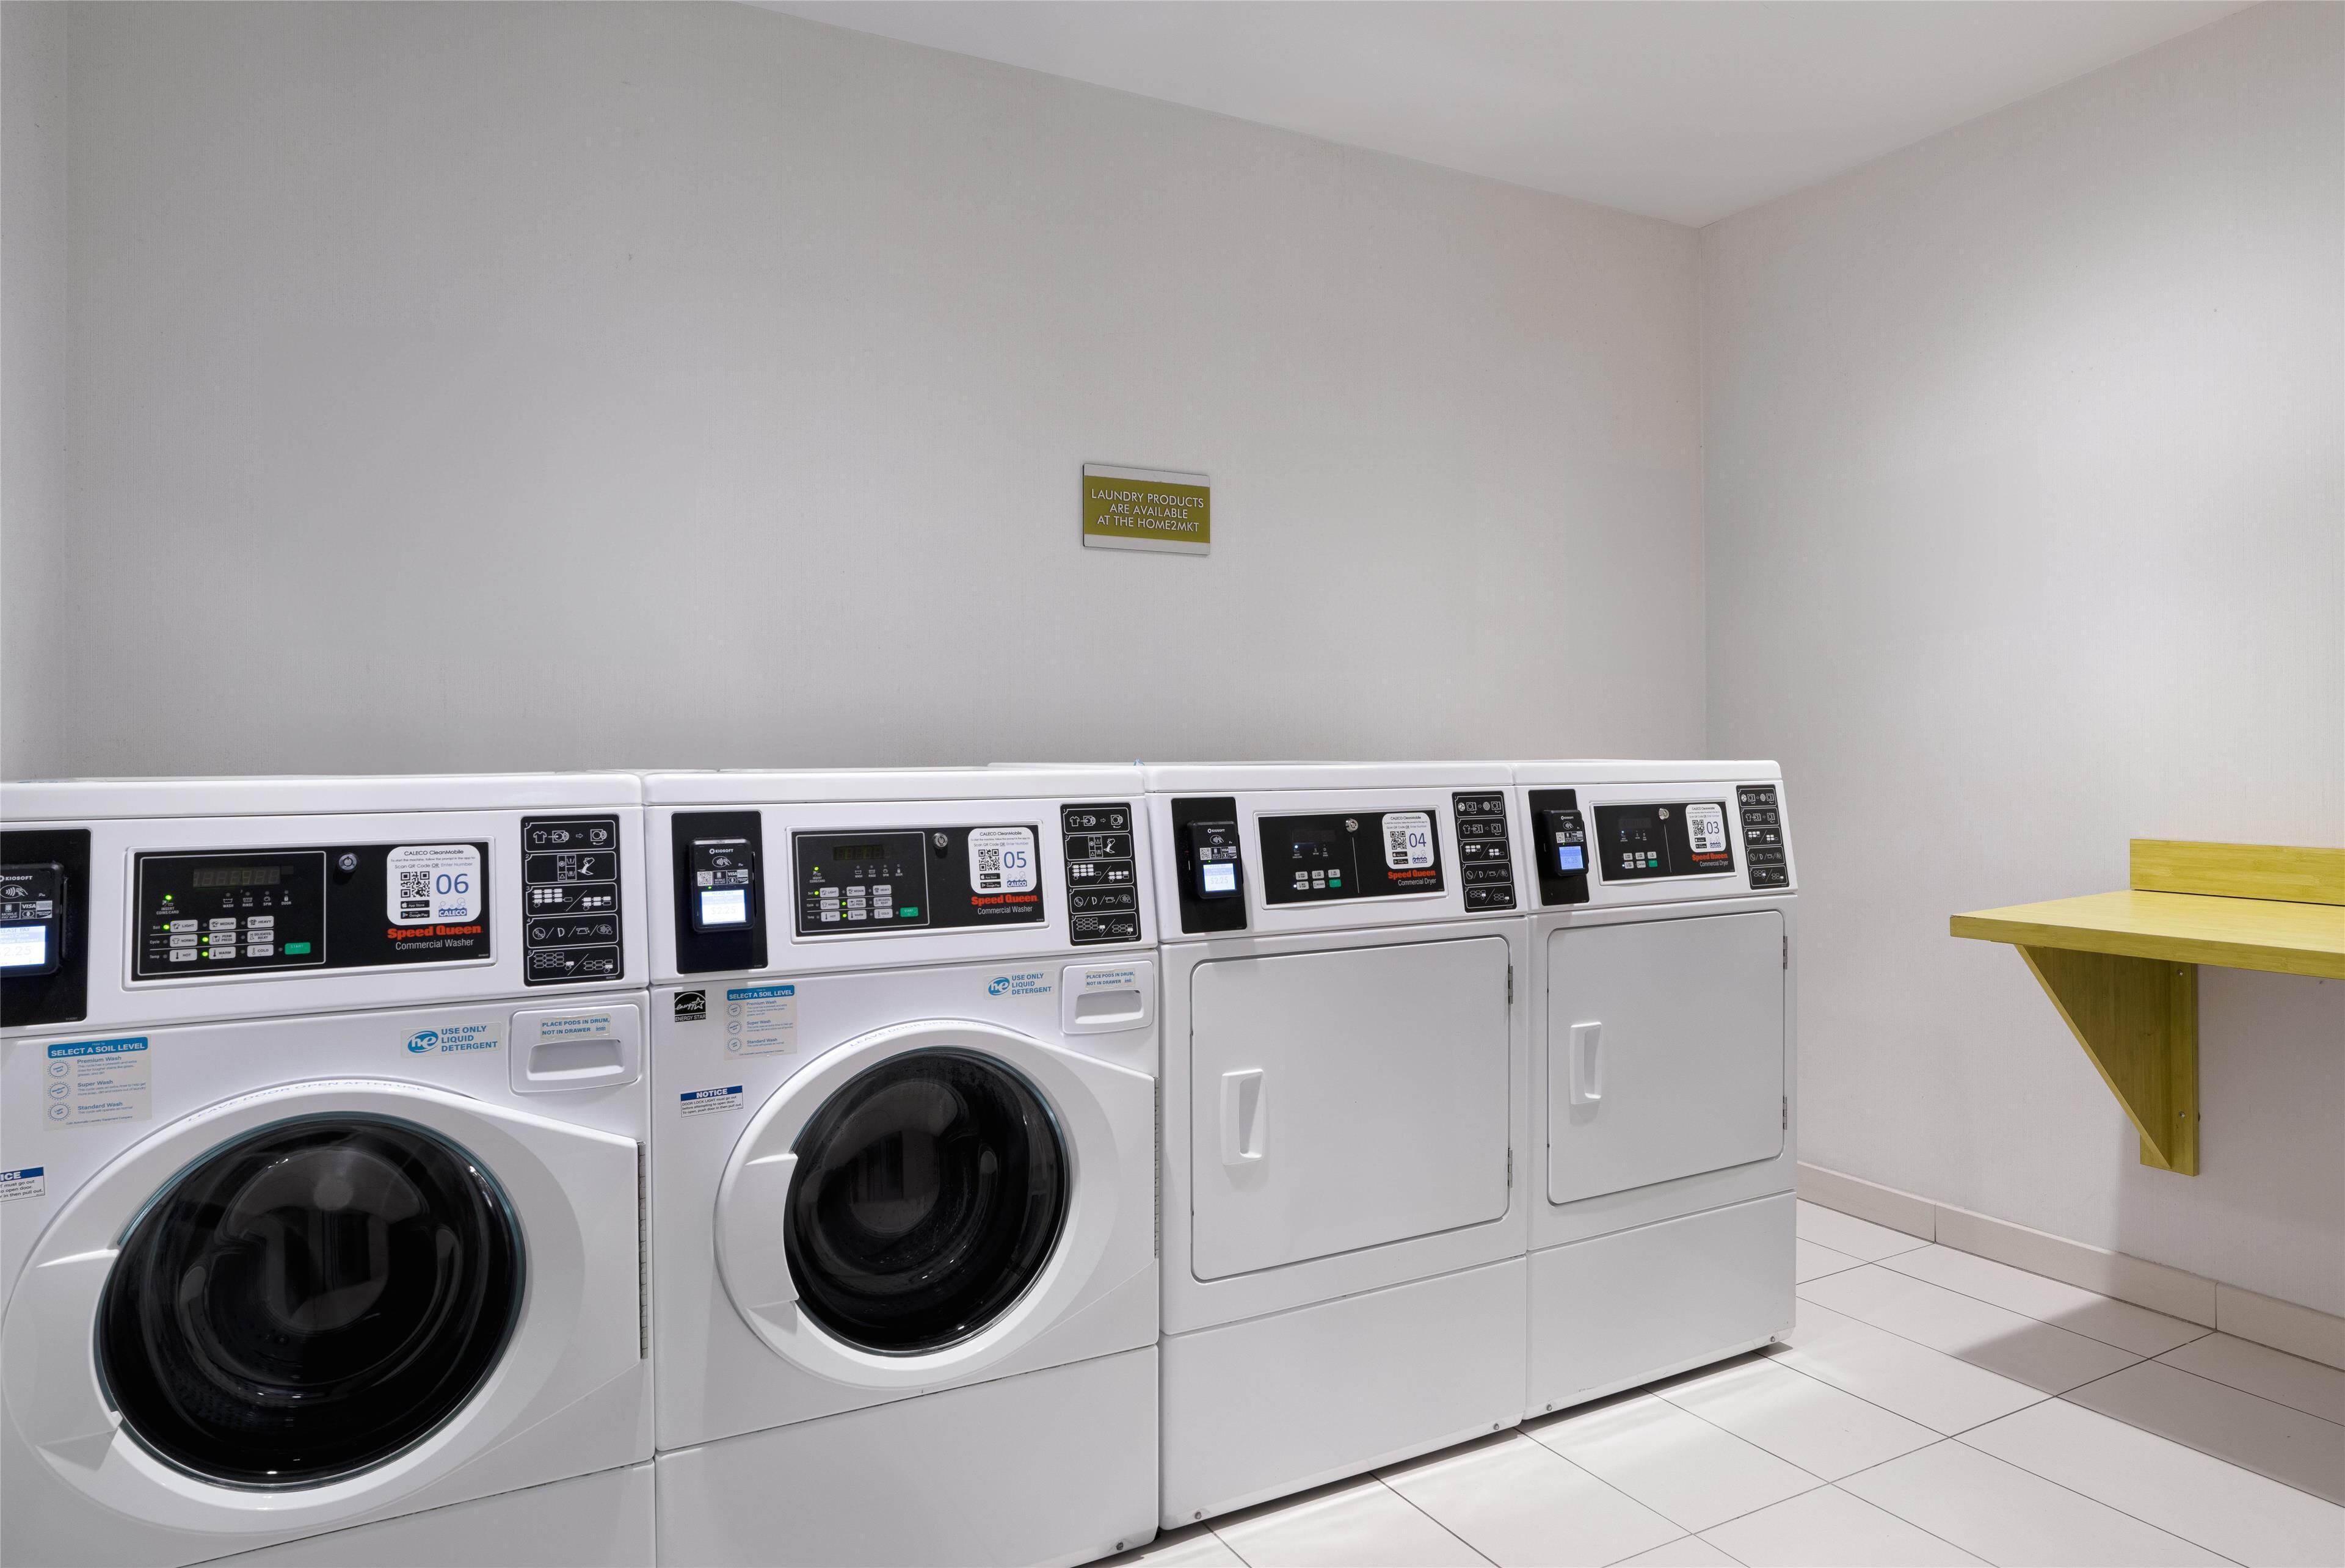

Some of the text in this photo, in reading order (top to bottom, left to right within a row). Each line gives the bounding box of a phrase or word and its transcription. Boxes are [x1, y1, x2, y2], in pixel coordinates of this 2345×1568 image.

[1092, 489, 1204, 507] LAUNDRY PRODUCTS
[1110, 504, 1188, 518] ARE AVAILABLE
[1097, 516, 1199, 532] AT THE HOME2MKT
[1707, 821, 1719, 834] 03
[1409, 833, 1427, 848] 04
[1004, 851, 1027, 868] 05
[1387, 871, 1411, 880] Speed
[436, 874, 469, 895] 06
[971, 895, 1004, 906] Speed
[387, 925, 481, 940] Speed Queen
[396, 938, 474, 950] Commercial Washer
[442, 1035, 474, 1044] LIQUID
[51, 1048, 85, 1056] SELECT
[442, 1041, 498, 1052] DETERGENT
[243, 1087, 290, 1101] DOOR
[696, 1089, 727, 1098] NOTICE
[0, 1172, 21, 1181] ICE
